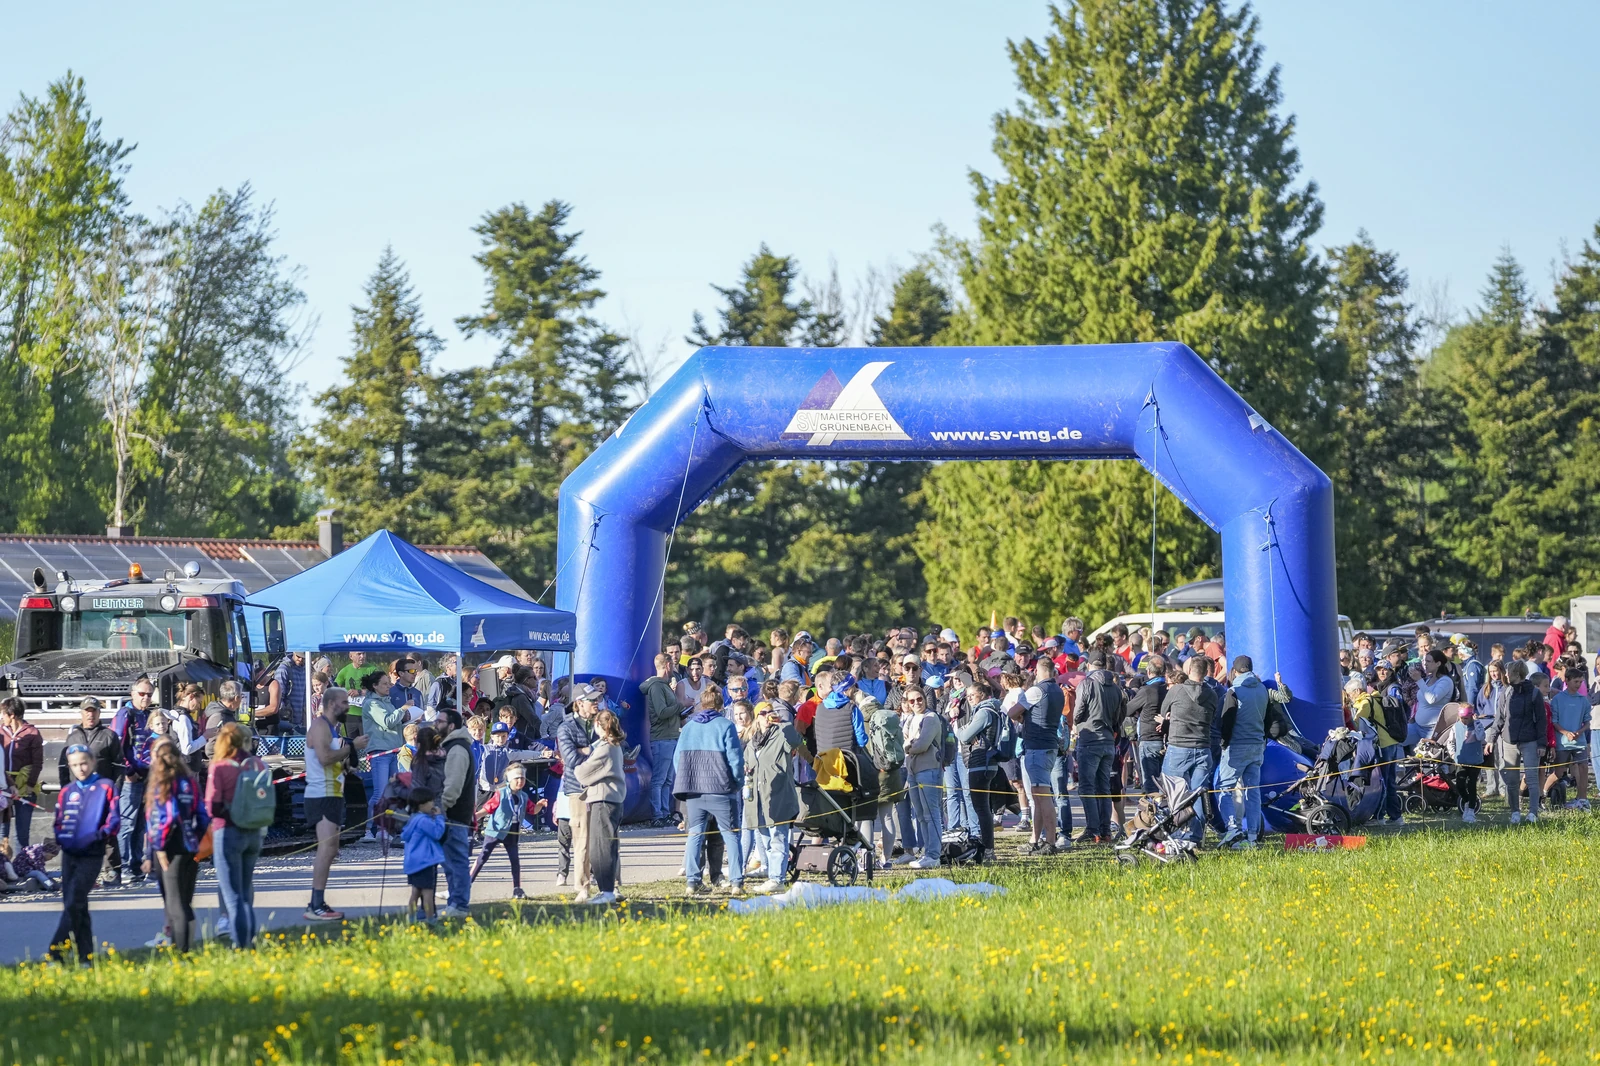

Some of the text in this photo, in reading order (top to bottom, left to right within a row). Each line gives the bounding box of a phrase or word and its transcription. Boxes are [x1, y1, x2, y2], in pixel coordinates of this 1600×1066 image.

[797, 412, 819, 431] SV
[820, 411, 889, 421] MAIERHÖFEN
[820, 423, 892, 432] GRÜNENBACH
[930, 427, 1083, 442] www.sv-mg.de
[92, 598, 144, 609] LEITNER
[343, 631, 445, 646] www.sv-mg.de
